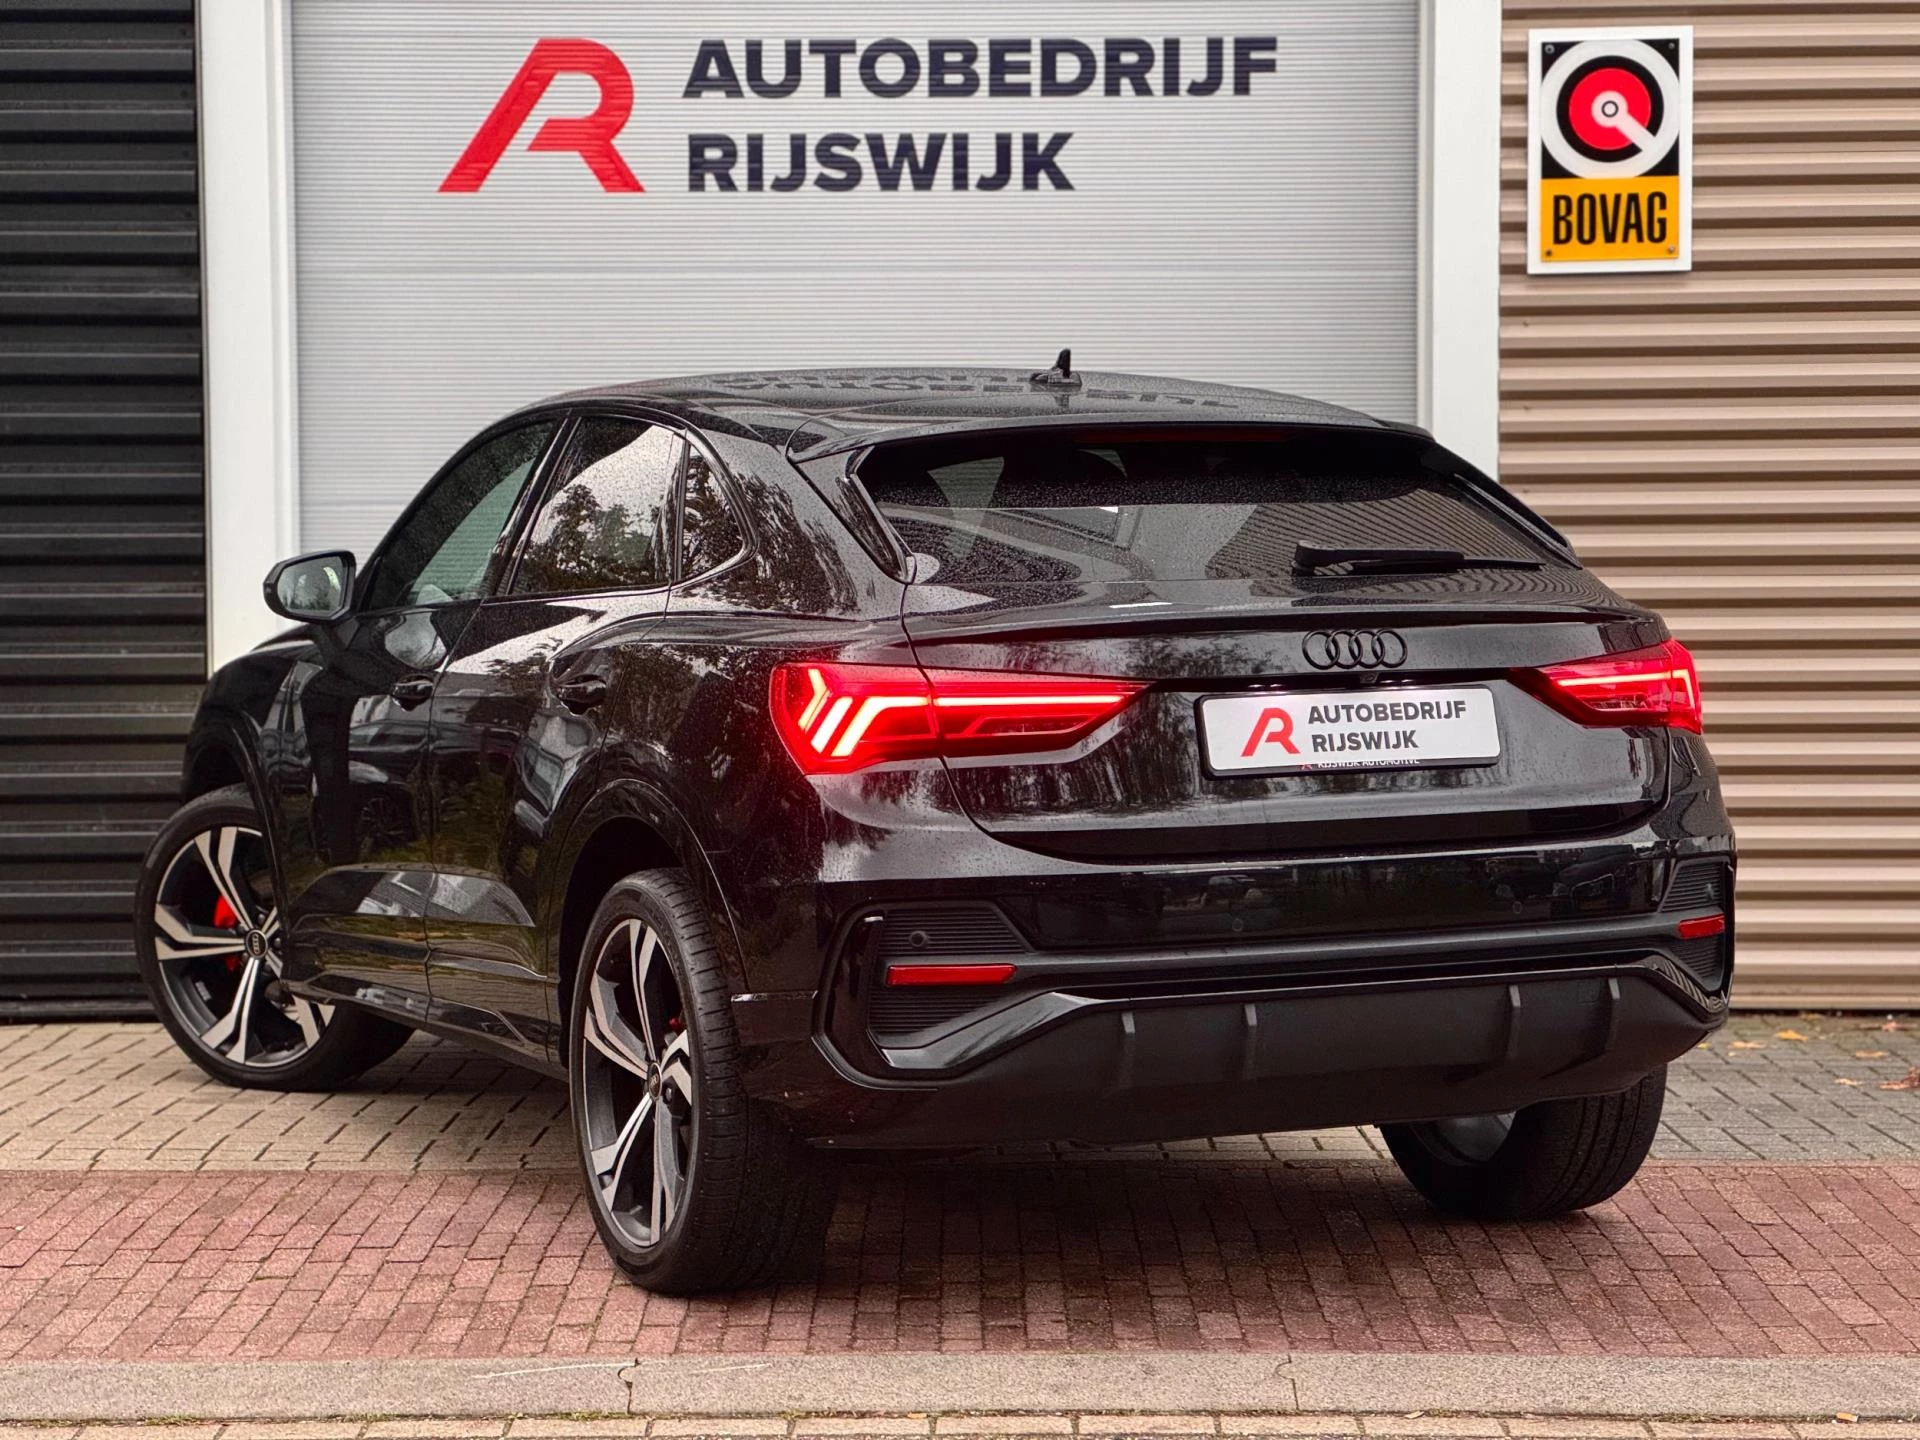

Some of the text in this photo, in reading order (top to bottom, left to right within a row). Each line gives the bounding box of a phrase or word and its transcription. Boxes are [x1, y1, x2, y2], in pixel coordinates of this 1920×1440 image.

[683, 37, 1278, 98] AUTOBEDRIJF
[688, 133, 1075, 192] RIJSWIJK
[1552, 191, 1667, 246] BOVAG
[1308, 700, 1466, 725] AUTOBEDRIJF
[1312, 730, 1419, 753] RIJSWIJK
